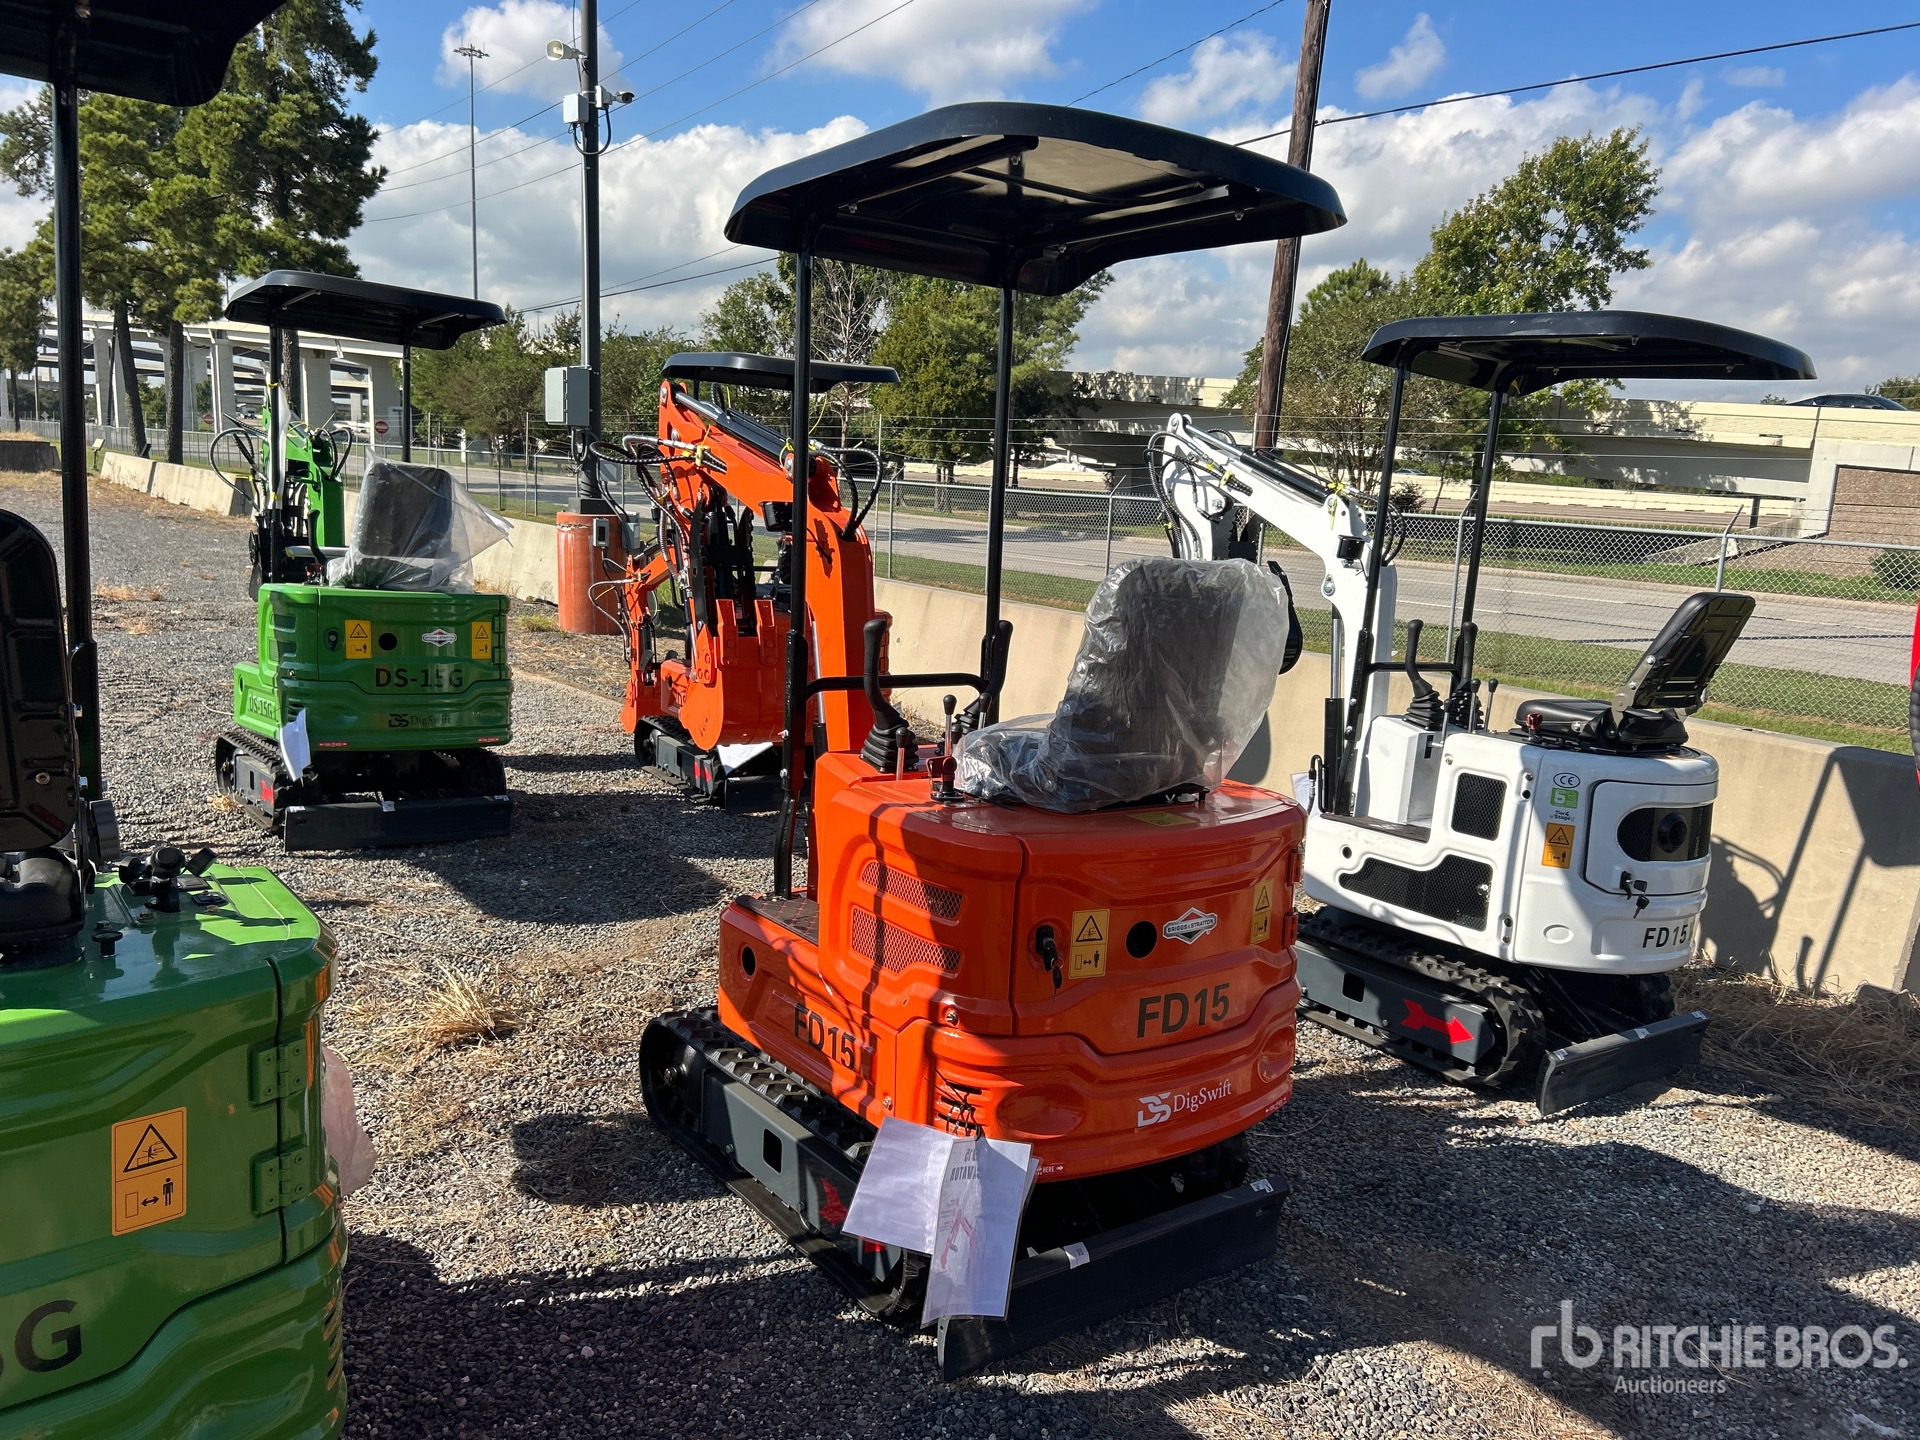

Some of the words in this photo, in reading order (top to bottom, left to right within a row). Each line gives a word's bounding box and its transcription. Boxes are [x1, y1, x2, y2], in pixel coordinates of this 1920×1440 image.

[375, 667, 463, 688] DS-15G
[410, 714, 451, 727] DigSwift
[1642, 924, 1688, 949] FD15
[1137, 982, 1230, 1038] FD15
[794, 1003, 856, 1071] FD15
[1137, 1091, 1173, 1127] DS
[1172, 1079, 1233, 1113] DigSwift
[1042, 1165, 1055, 1174] HERE
[0, 1300, 83, 1377] G
